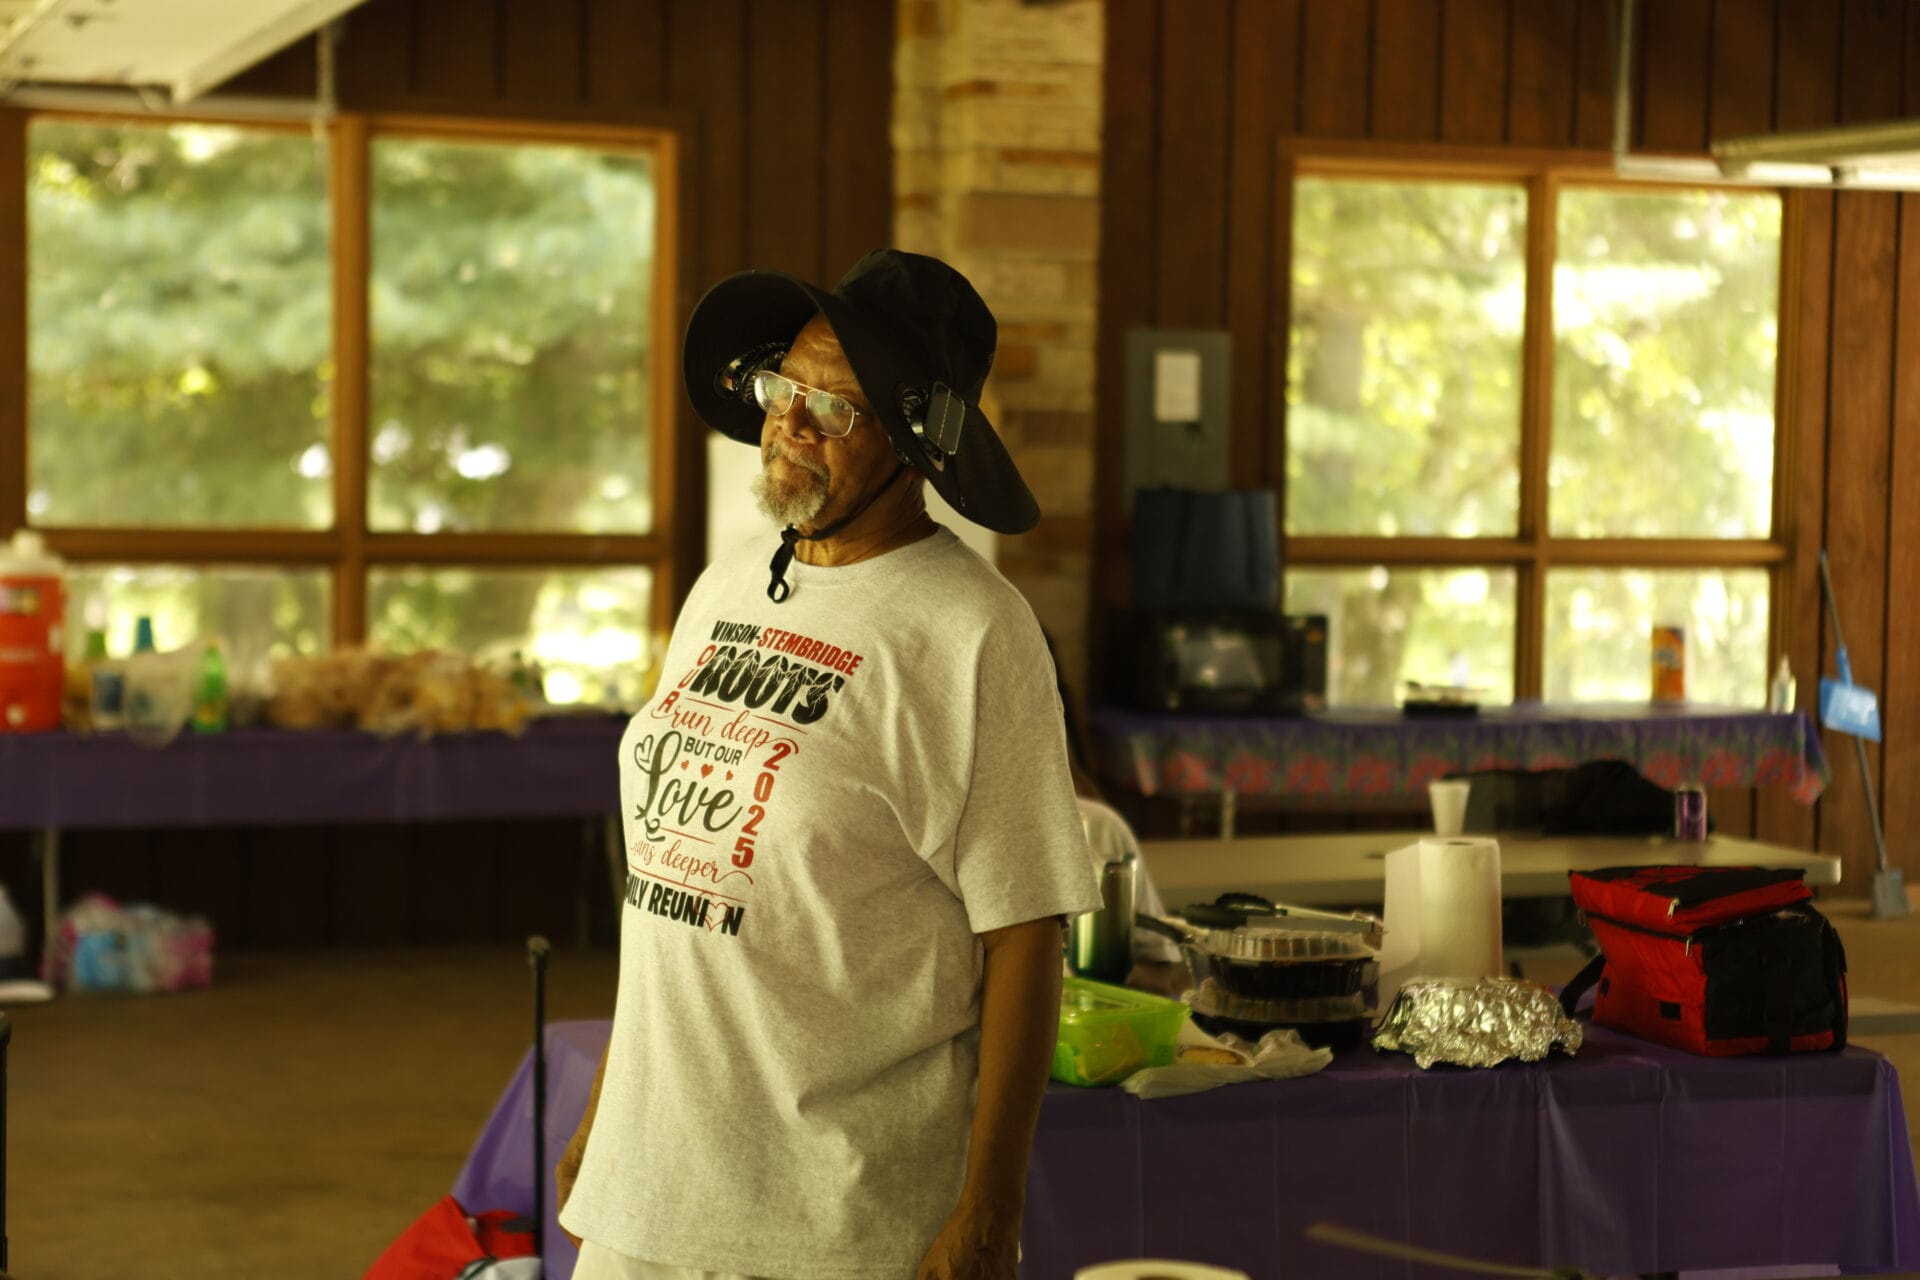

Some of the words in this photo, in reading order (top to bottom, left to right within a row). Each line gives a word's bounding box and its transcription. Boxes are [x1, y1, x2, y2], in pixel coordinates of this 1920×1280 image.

[710, 620, 863, 676] VINSON-STEMBRIDGE
[656, 644, 717, 713] OUR
[689, 645, 845, 725] ROOTS
[654, 705, 715, 736] run
[721, 710, 797, 760] deep
[683, 736, 715, 759] BUT
[714, 745, 743, 766] OUR
[634, 731, 743, 841] Love
[731, 742, 791, 868] 2025
[661, 840, 753, 885] deeper
[625, 873, 650, 910] MILY
